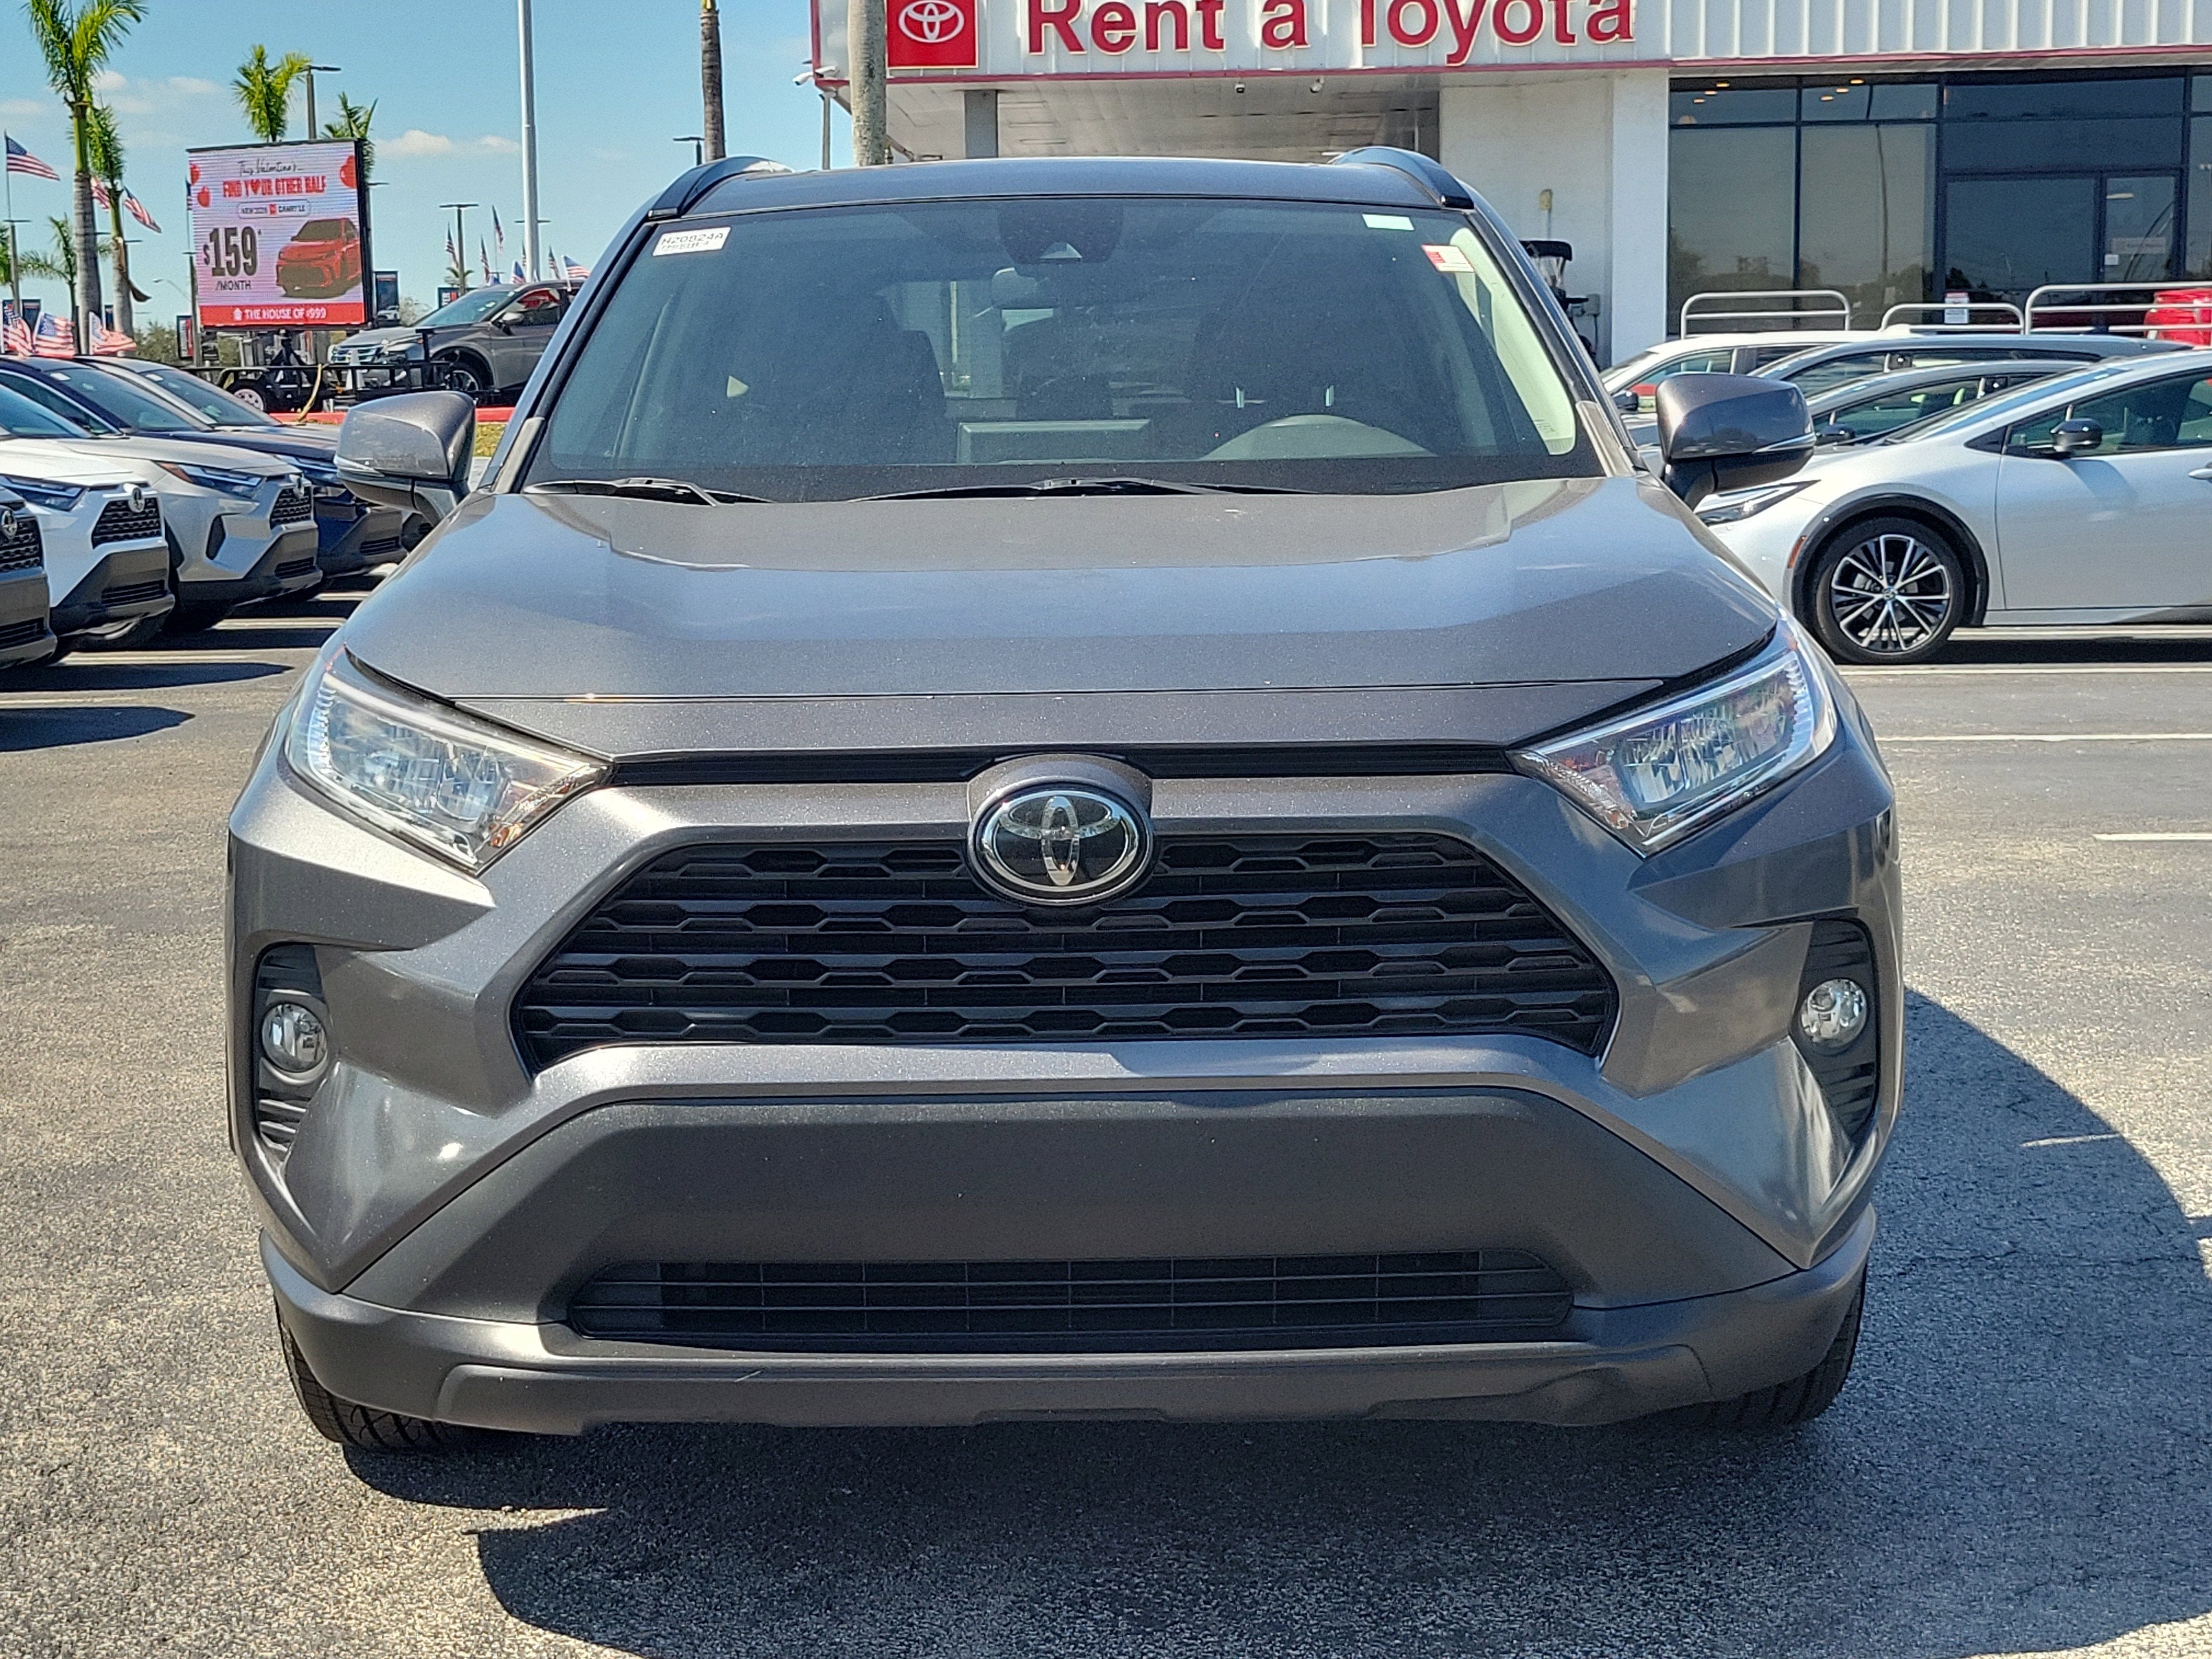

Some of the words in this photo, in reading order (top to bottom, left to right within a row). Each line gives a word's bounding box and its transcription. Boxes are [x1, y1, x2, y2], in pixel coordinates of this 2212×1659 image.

[1028, 0, 1226, 54] Rent
[1261, 0, 1311, 50] a
[244, 309, 261, 320] THE
[262, 309, 291, 319] HOUSE
[293, 308, 304, 319] OF
